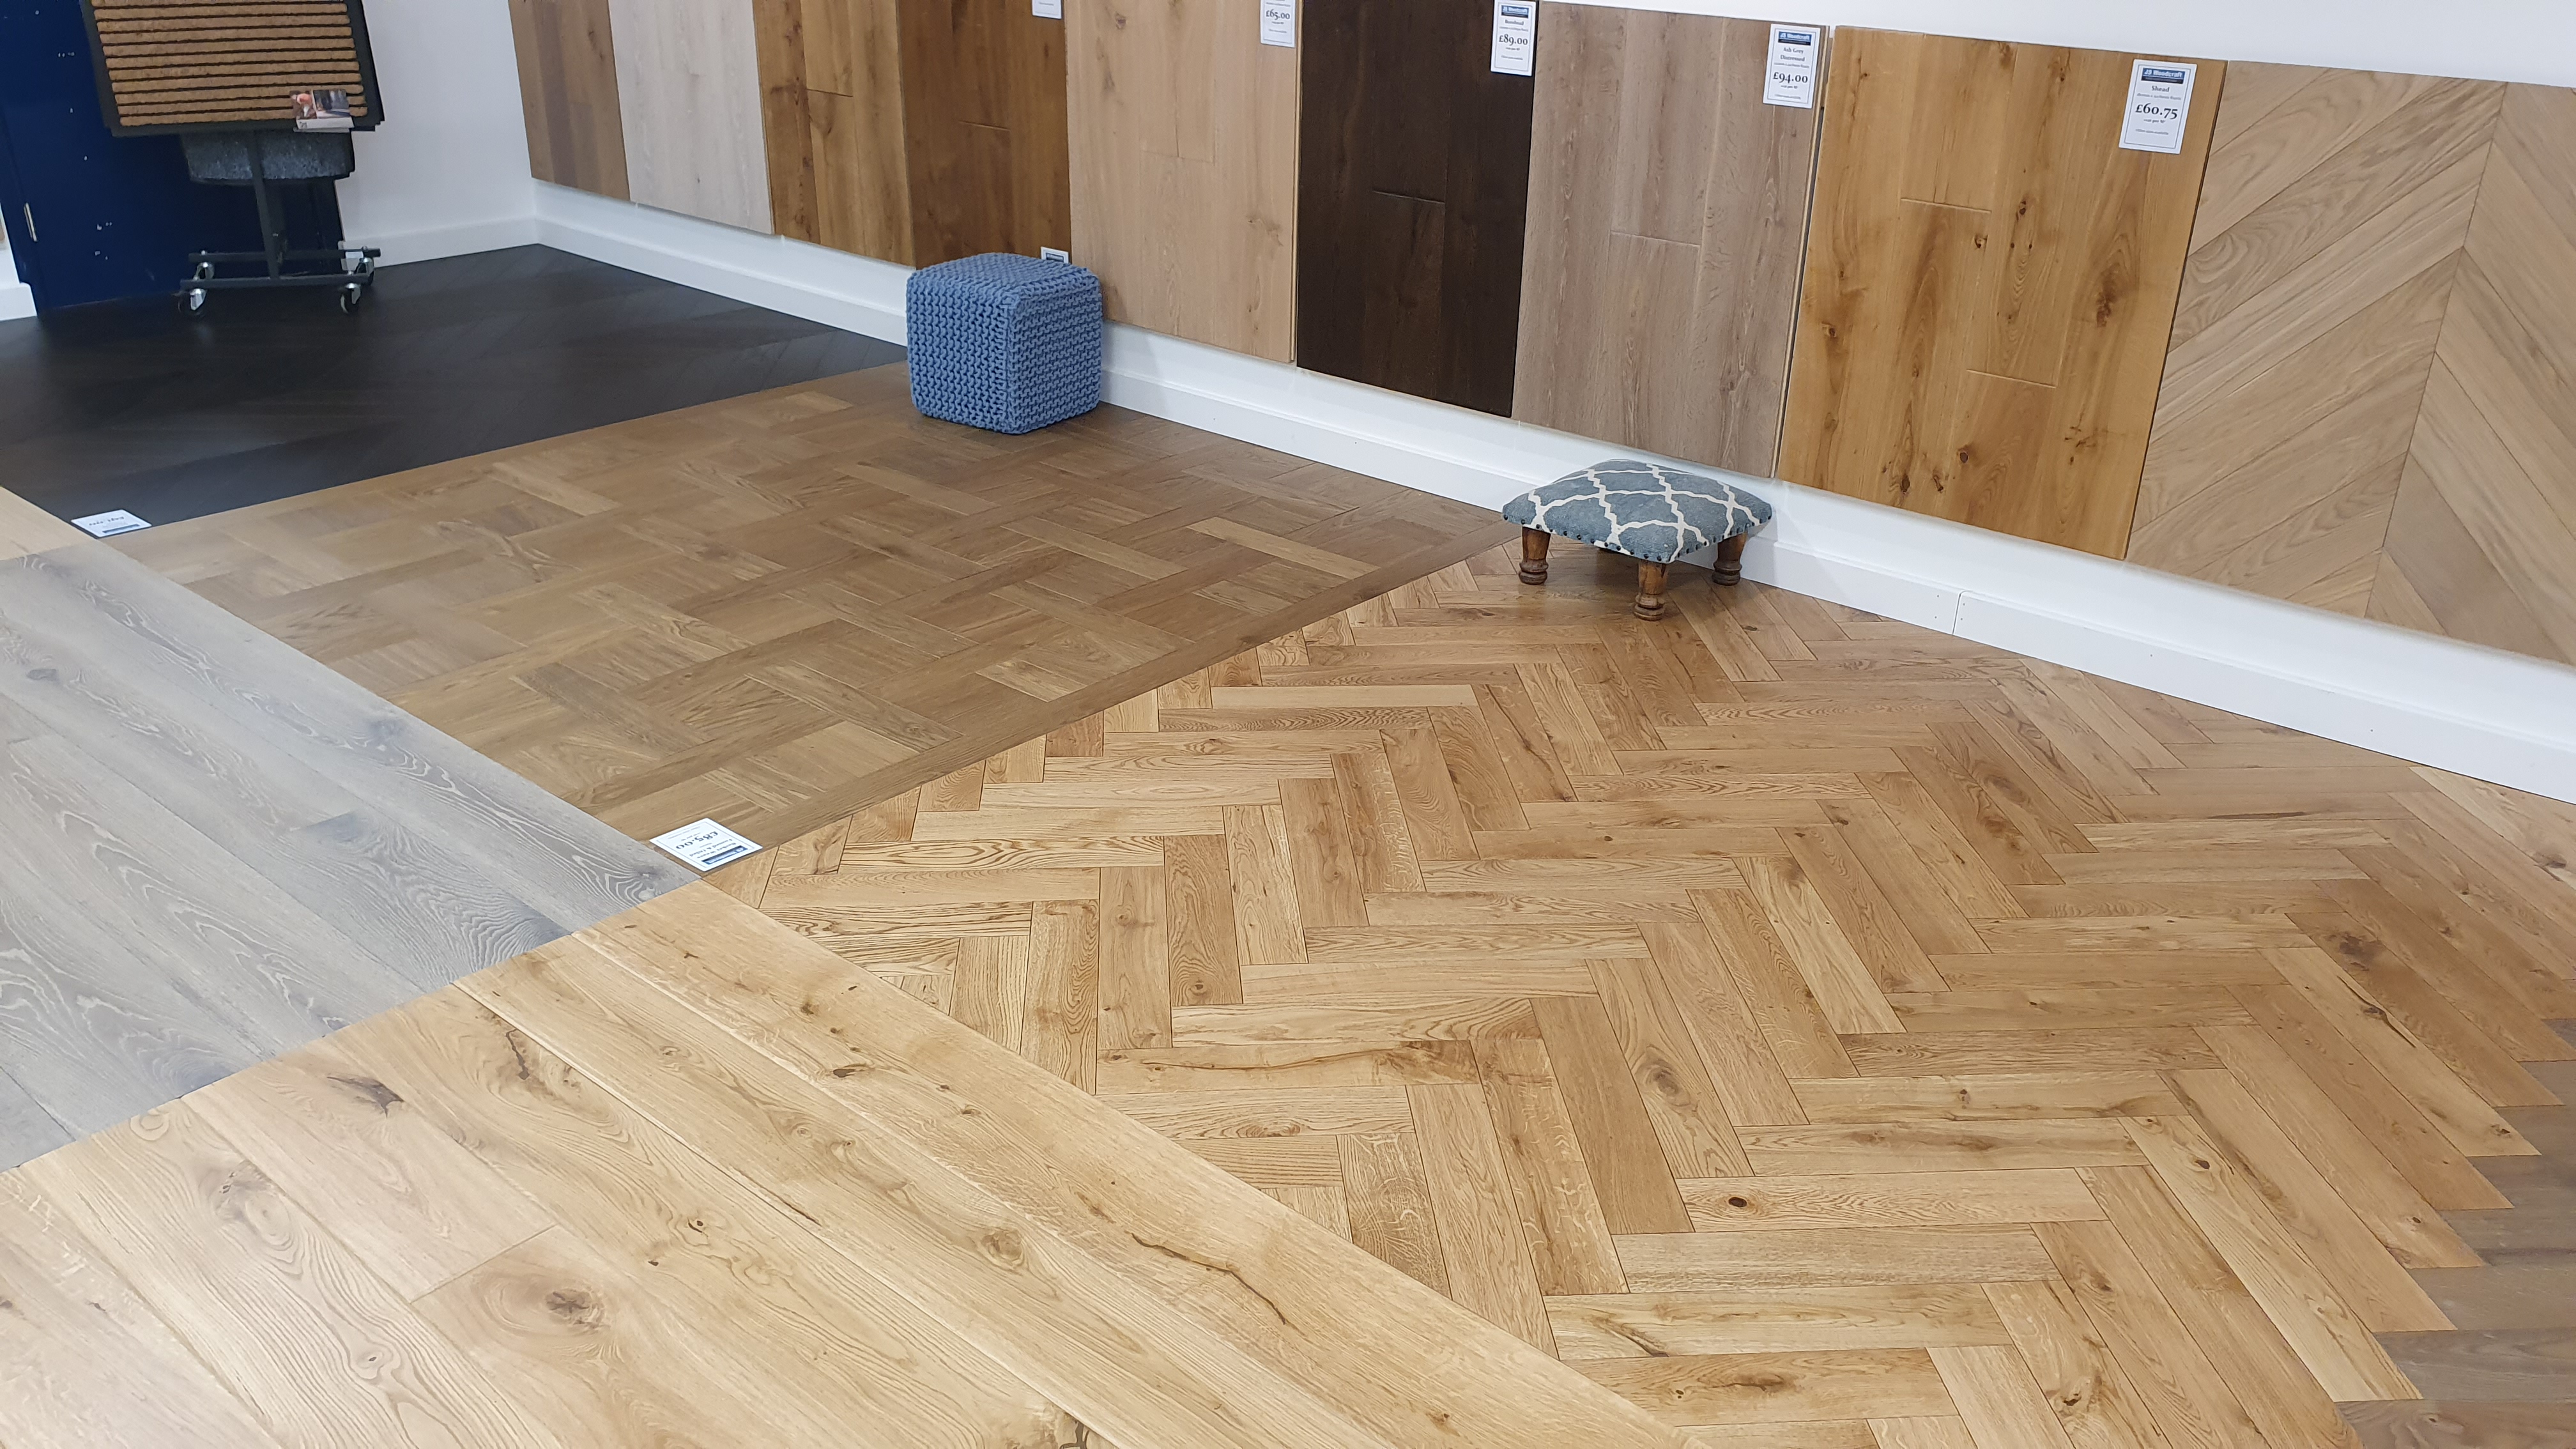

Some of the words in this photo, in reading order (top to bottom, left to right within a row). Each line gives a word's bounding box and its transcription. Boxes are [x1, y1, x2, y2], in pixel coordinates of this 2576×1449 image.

[1266, 9, 1290, 20] £65.00
[1499, 34, 1528, 46] £89.00
[1773, 72, 1808, 84] £94.00
[2135, 102, 2178, 119] £60.75
[676, 831, 718, 849] £85.00
